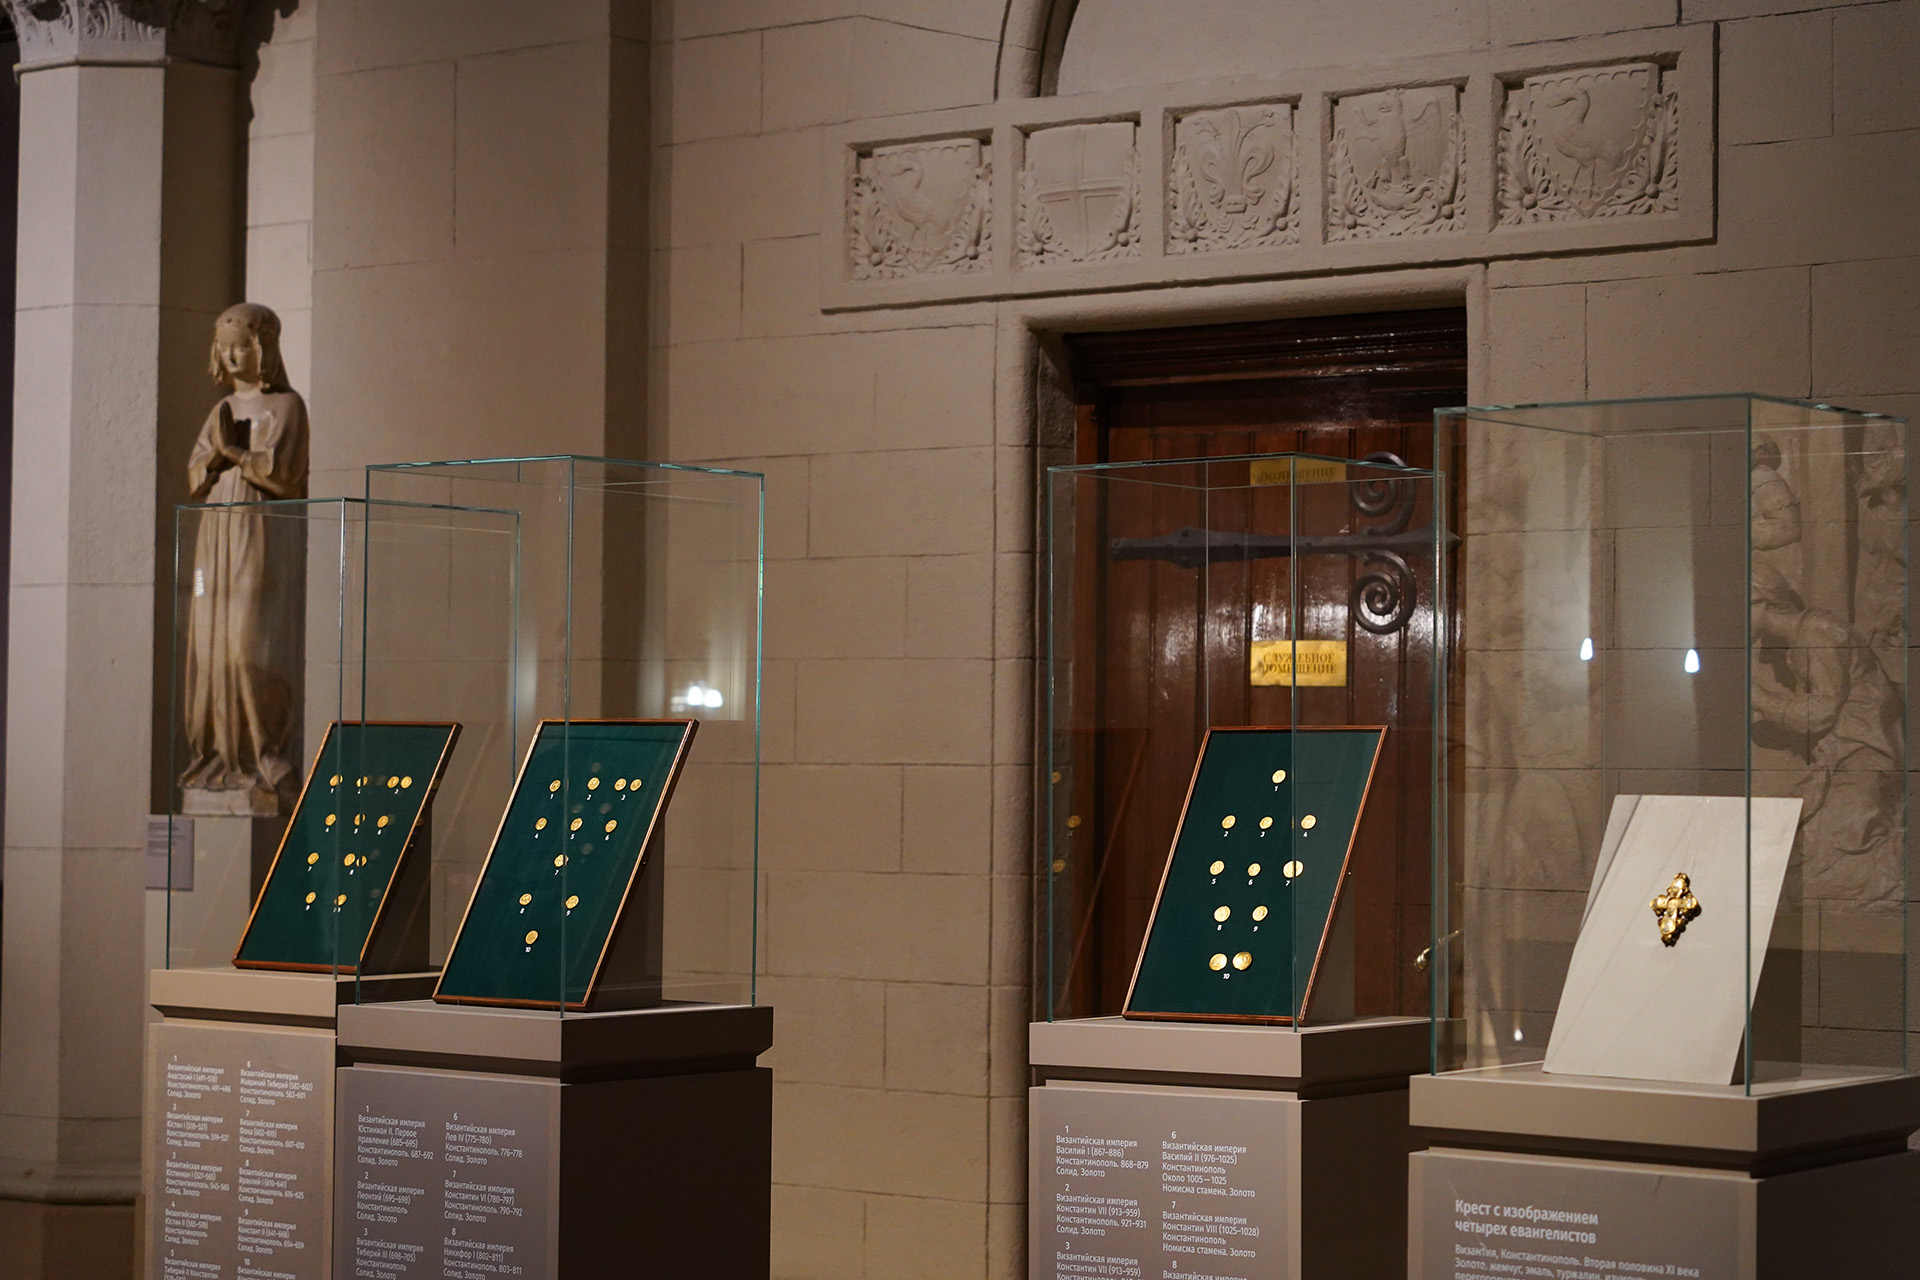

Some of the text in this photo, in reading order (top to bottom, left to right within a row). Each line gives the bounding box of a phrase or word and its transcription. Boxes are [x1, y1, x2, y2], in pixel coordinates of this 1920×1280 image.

[366, 1105, 369, 1113] 1
[453, 1112, 458, 1120] 6
[1065, 1125, 1069, 1133] 1
[1171, 1130, 1176, 1139] 6
[1056, 1135, 1137, 1148] Византийская империя
[1056, 1146, 1085, 1155] Василий
[1162, 1141, 1246, 1154] Византийская империя
[1056, 1156, 1119, 1168] Константинополь.
[1162, 1152, 1192, 1161] Василий
[1056, 1166, 1105, 1177] Солид. Золото
[1162, 1162, 1226, 1174] Константинополь
[365, 1171, 369, 1179] 2
[452, 1170, 456, 1178] 7
[1162, 1173, 1185, 1182] Около
[1065, 1183, 1069, 1191] 2
[1162, 1184, 1255, 1197] Номисма стамена. Золото
[1056, 1193, 1137, 1207] Византийская империя
[1171, 1200, 1176, 1209] 7
[1056, 1204, 1096, 1214] Константин
[1098, 1206, 1107, 1215] VII
[1455, 1199, 1598, 1225] Крест с изображением
[1056, 1214, 1119, 1227] Константинополь.
[1162, 1211, 1247, 1225] Византийская империя
[364, 1228, 368, 1236] 3
[452, 1228, 456, 1236] 8
[1056, 1224, 1105, 1236] Солид. Золото
[1162, 1222, 1204, 1232] Константин
[1205, 1225, 1217, 1233] VIII
[1455, 1220, 1596, 1243] четырех евангелистов
[1162, 1232, 1226, 1245] Константинополь
[1065, 1241, 1070, 1250] 3
[1163, 1243, 1255, 1258] Номисма стамена. Золото
[1056, 1251, 1138, 1266] Византийская империя
[1455, 1244, 1699, 1278] Византия, Константинополь. Вторая половина XI века
[1056, 1262, 1096, 1273] Константин
[1098, 1265, 1107, 1274] VII
[1172, 1260, 1177, 1269] 8
[1455, 1257, 1487, 1271] Золото,
[1489, 1262, 1523, 1275] жемчуг,
[1525, 1265, 1554, 1278] эмаль,
[1163, 1270, 1213, 1280] Византийская
